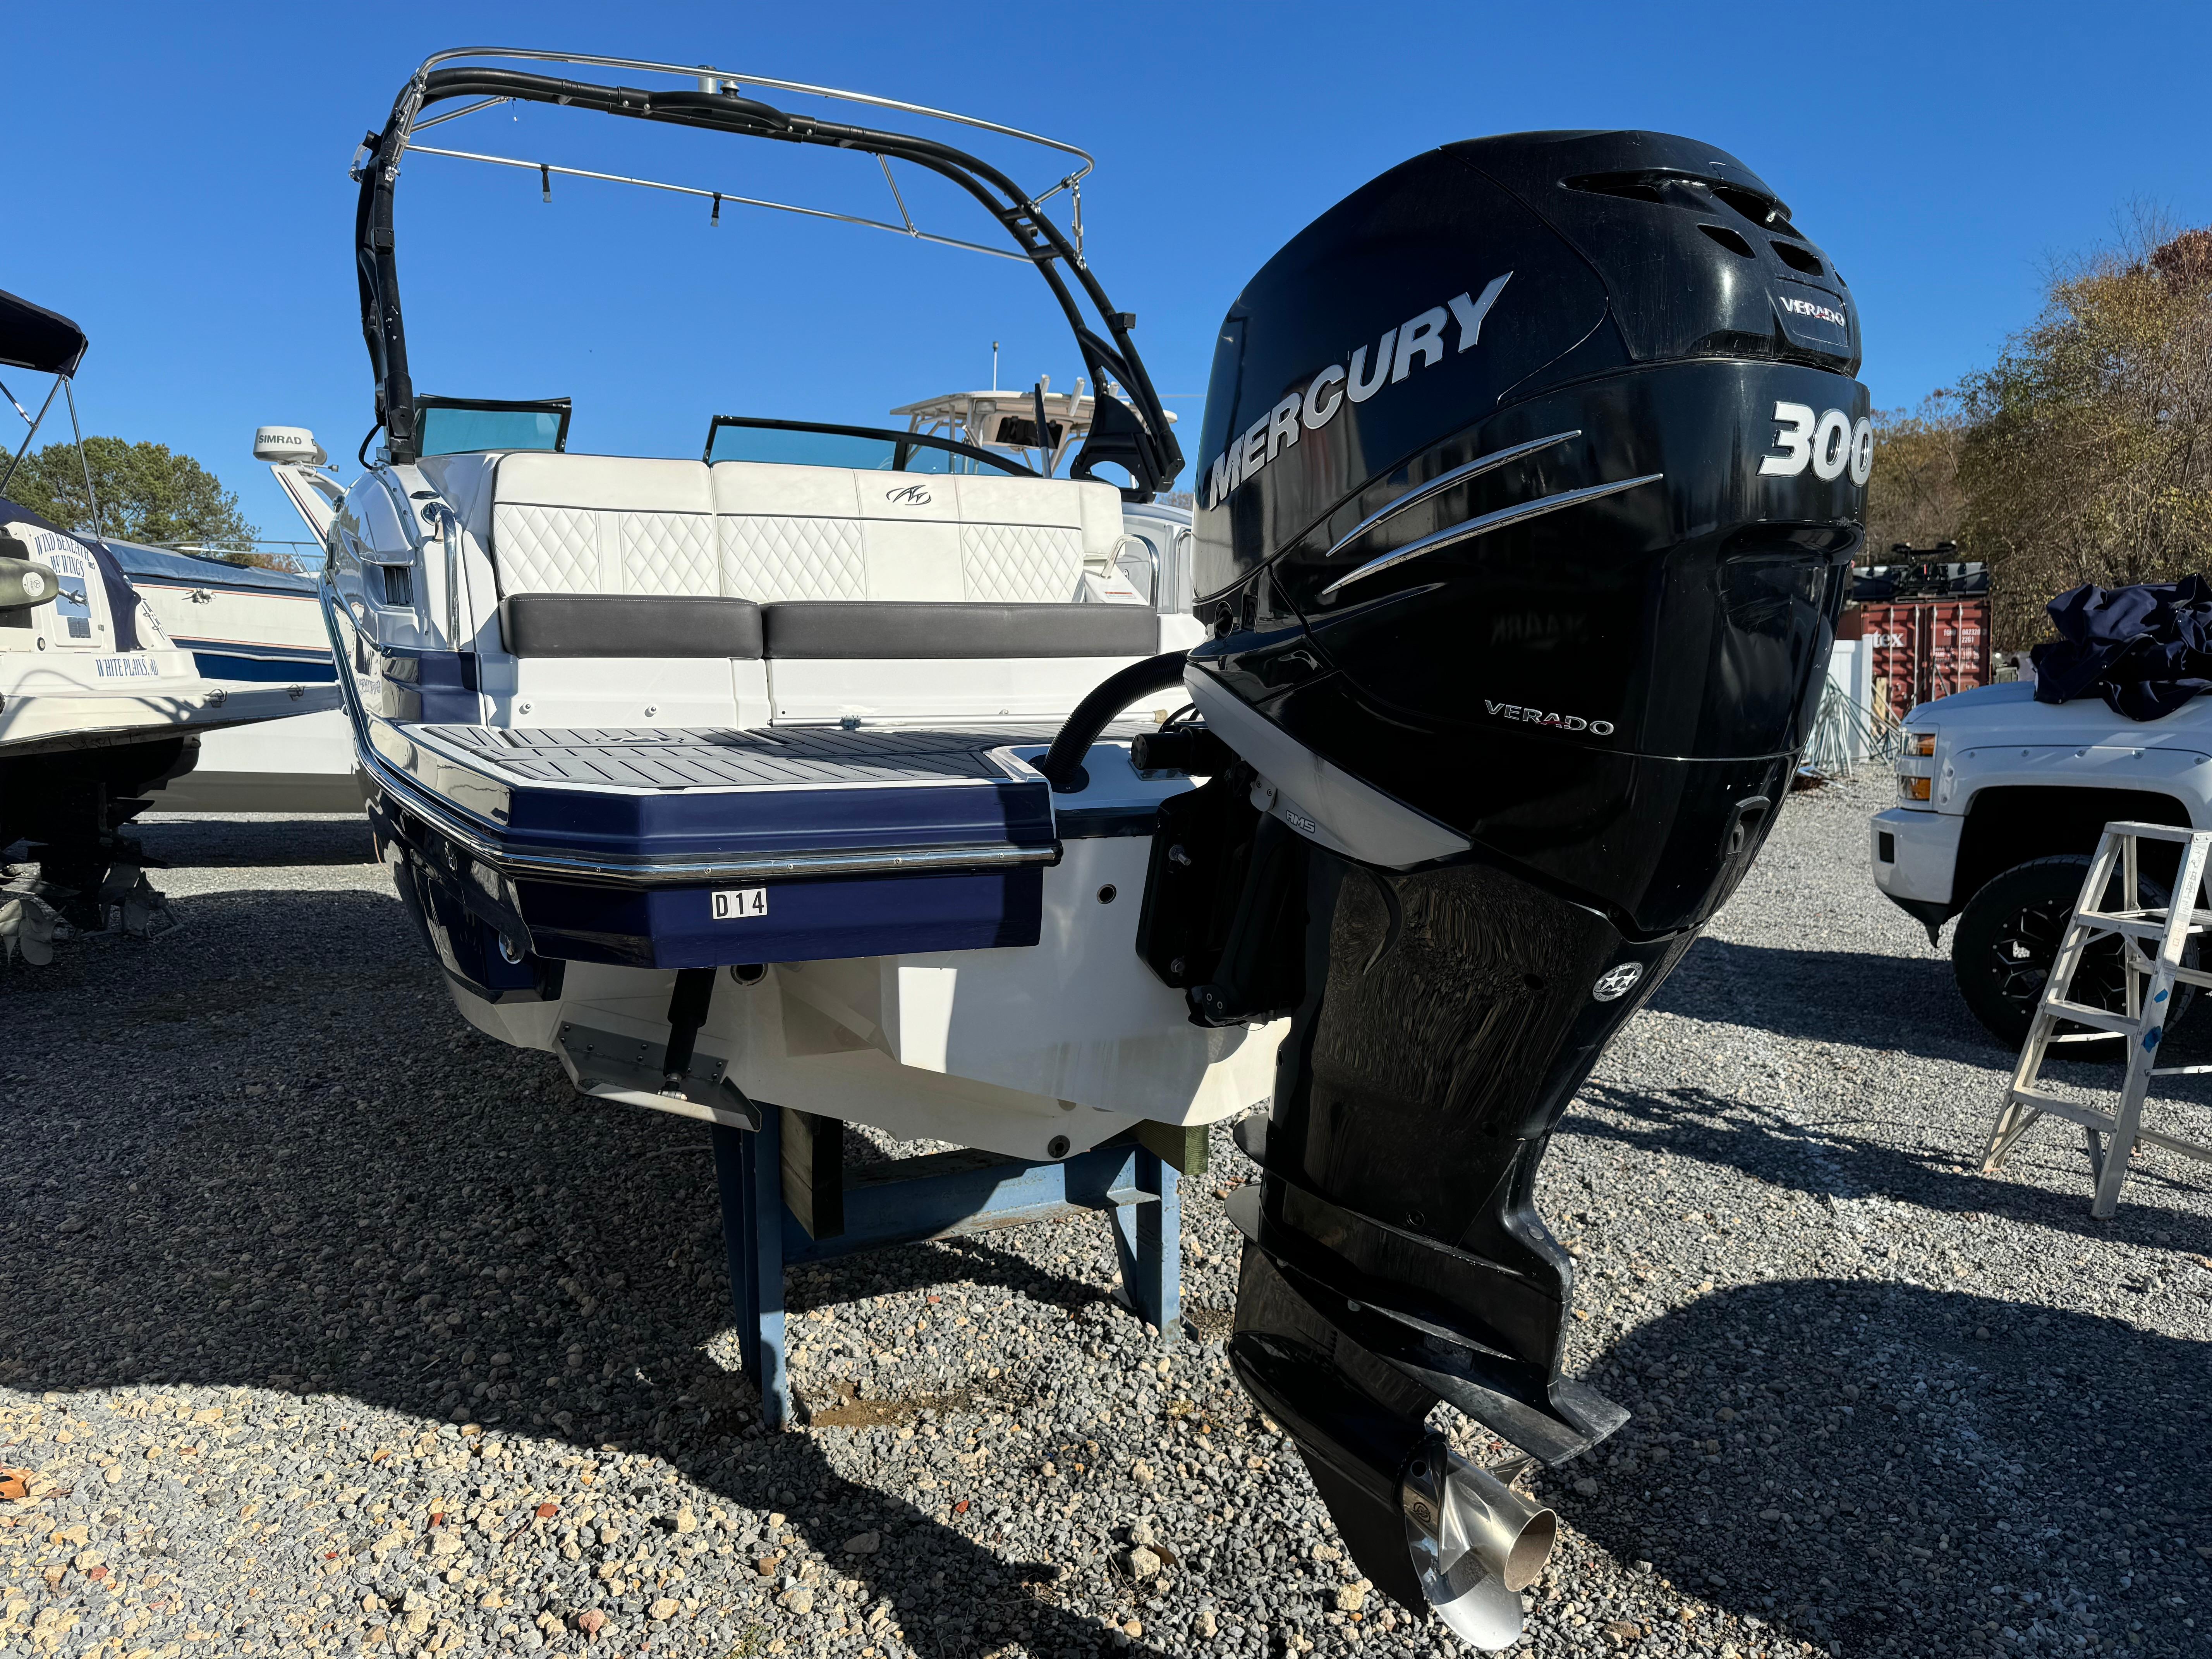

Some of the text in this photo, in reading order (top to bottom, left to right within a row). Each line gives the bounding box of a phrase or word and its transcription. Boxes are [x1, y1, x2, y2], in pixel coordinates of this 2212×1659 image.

[1779, 297, 1845, 327] VERADO
[1209, 270, 1514, 511] MERCURY
[258, 434, 302, 445] SIMRAD
[1757, 401, 1874, 487] 300
[34, 532, 89, 561] WIND BENEATH
[50, 555, 84, 578] MY WINGS
[1873, 630, 1904, 648] tex
[95, 658, 123, 677] WHITE
[123, 658, 149, 677] PLAINS,
[1484, 699, 1614, 735] VERADO
[1286, 809, 1315, 834] AMS
[715, 891, 765, 917] D14
